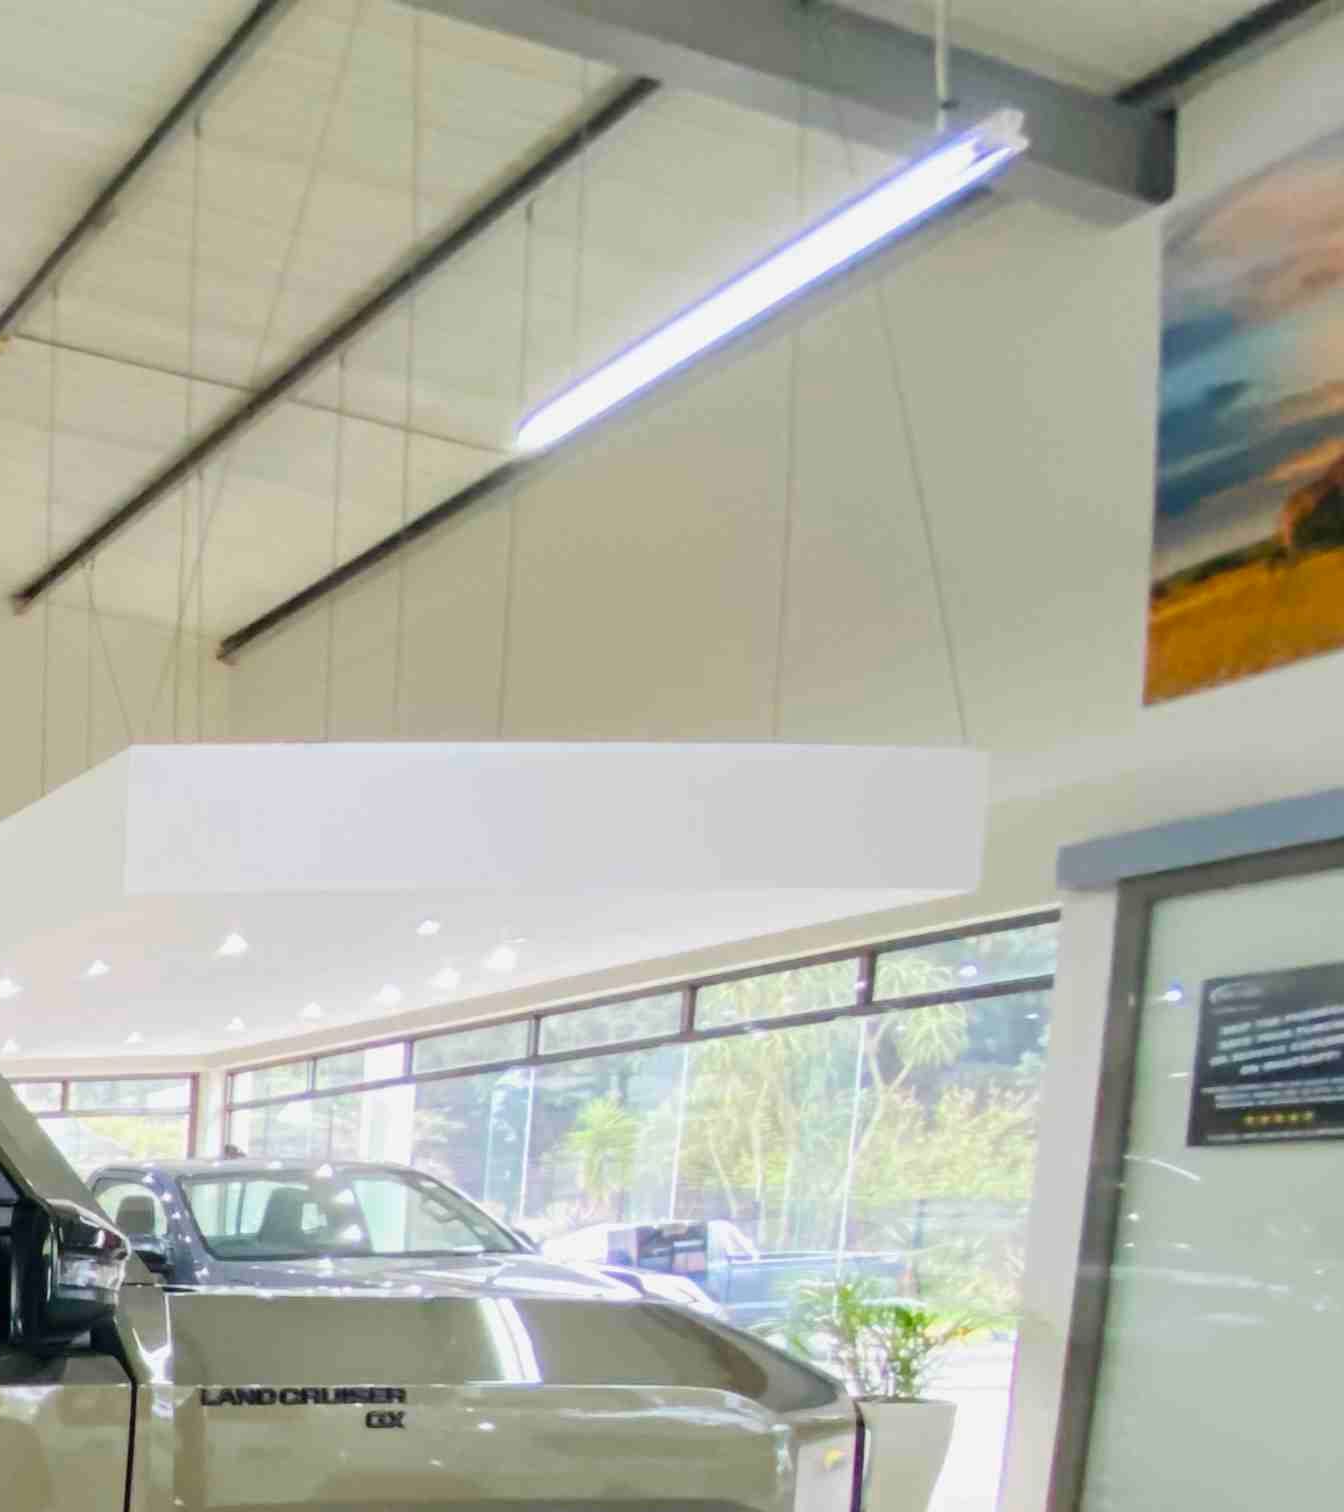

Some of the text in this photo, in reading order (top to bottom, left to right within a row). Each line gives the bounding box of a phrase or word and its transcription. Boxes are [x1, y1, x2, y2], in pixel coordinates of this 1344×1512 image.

[200, 1387, 407, 1406] LAND CRUISER
[365, 1410, 405, 1429] GX
